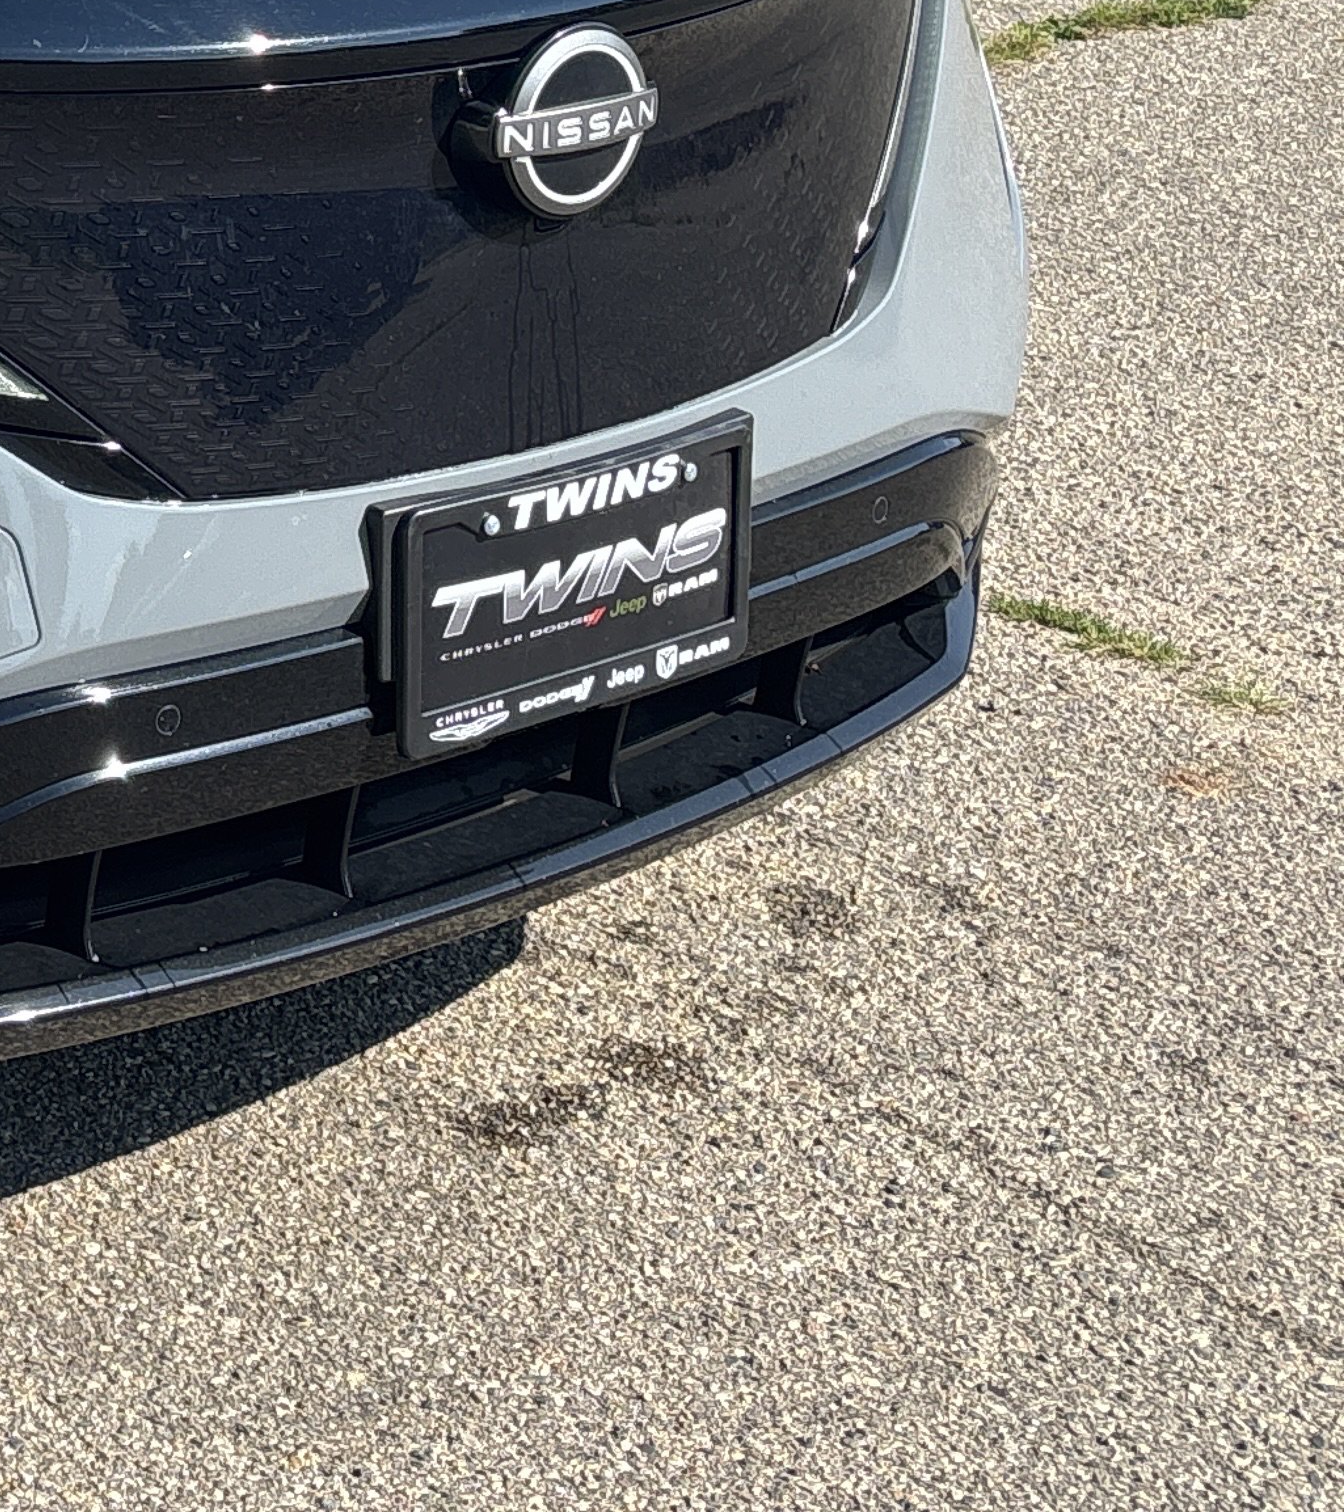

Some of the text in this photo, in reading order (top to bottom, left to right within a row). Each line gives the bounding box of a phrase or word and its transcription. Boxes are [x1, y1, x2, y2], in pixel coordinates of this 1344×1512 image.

[502, 93, 656, 155] NISSAN
[507, 453, 680, 530] TWINS
[431, 507, 727, 639] TWINS
[439, 633, 524, 662] CHRYSLER
[609, 595, 647, 618] Jeep
[668, 568, 719, 597] RAM
[435, 698, 505, 728] CHRYSLER
[606, 664, 645, 689] Jeep
[678, 636, 730, 665] RAM
